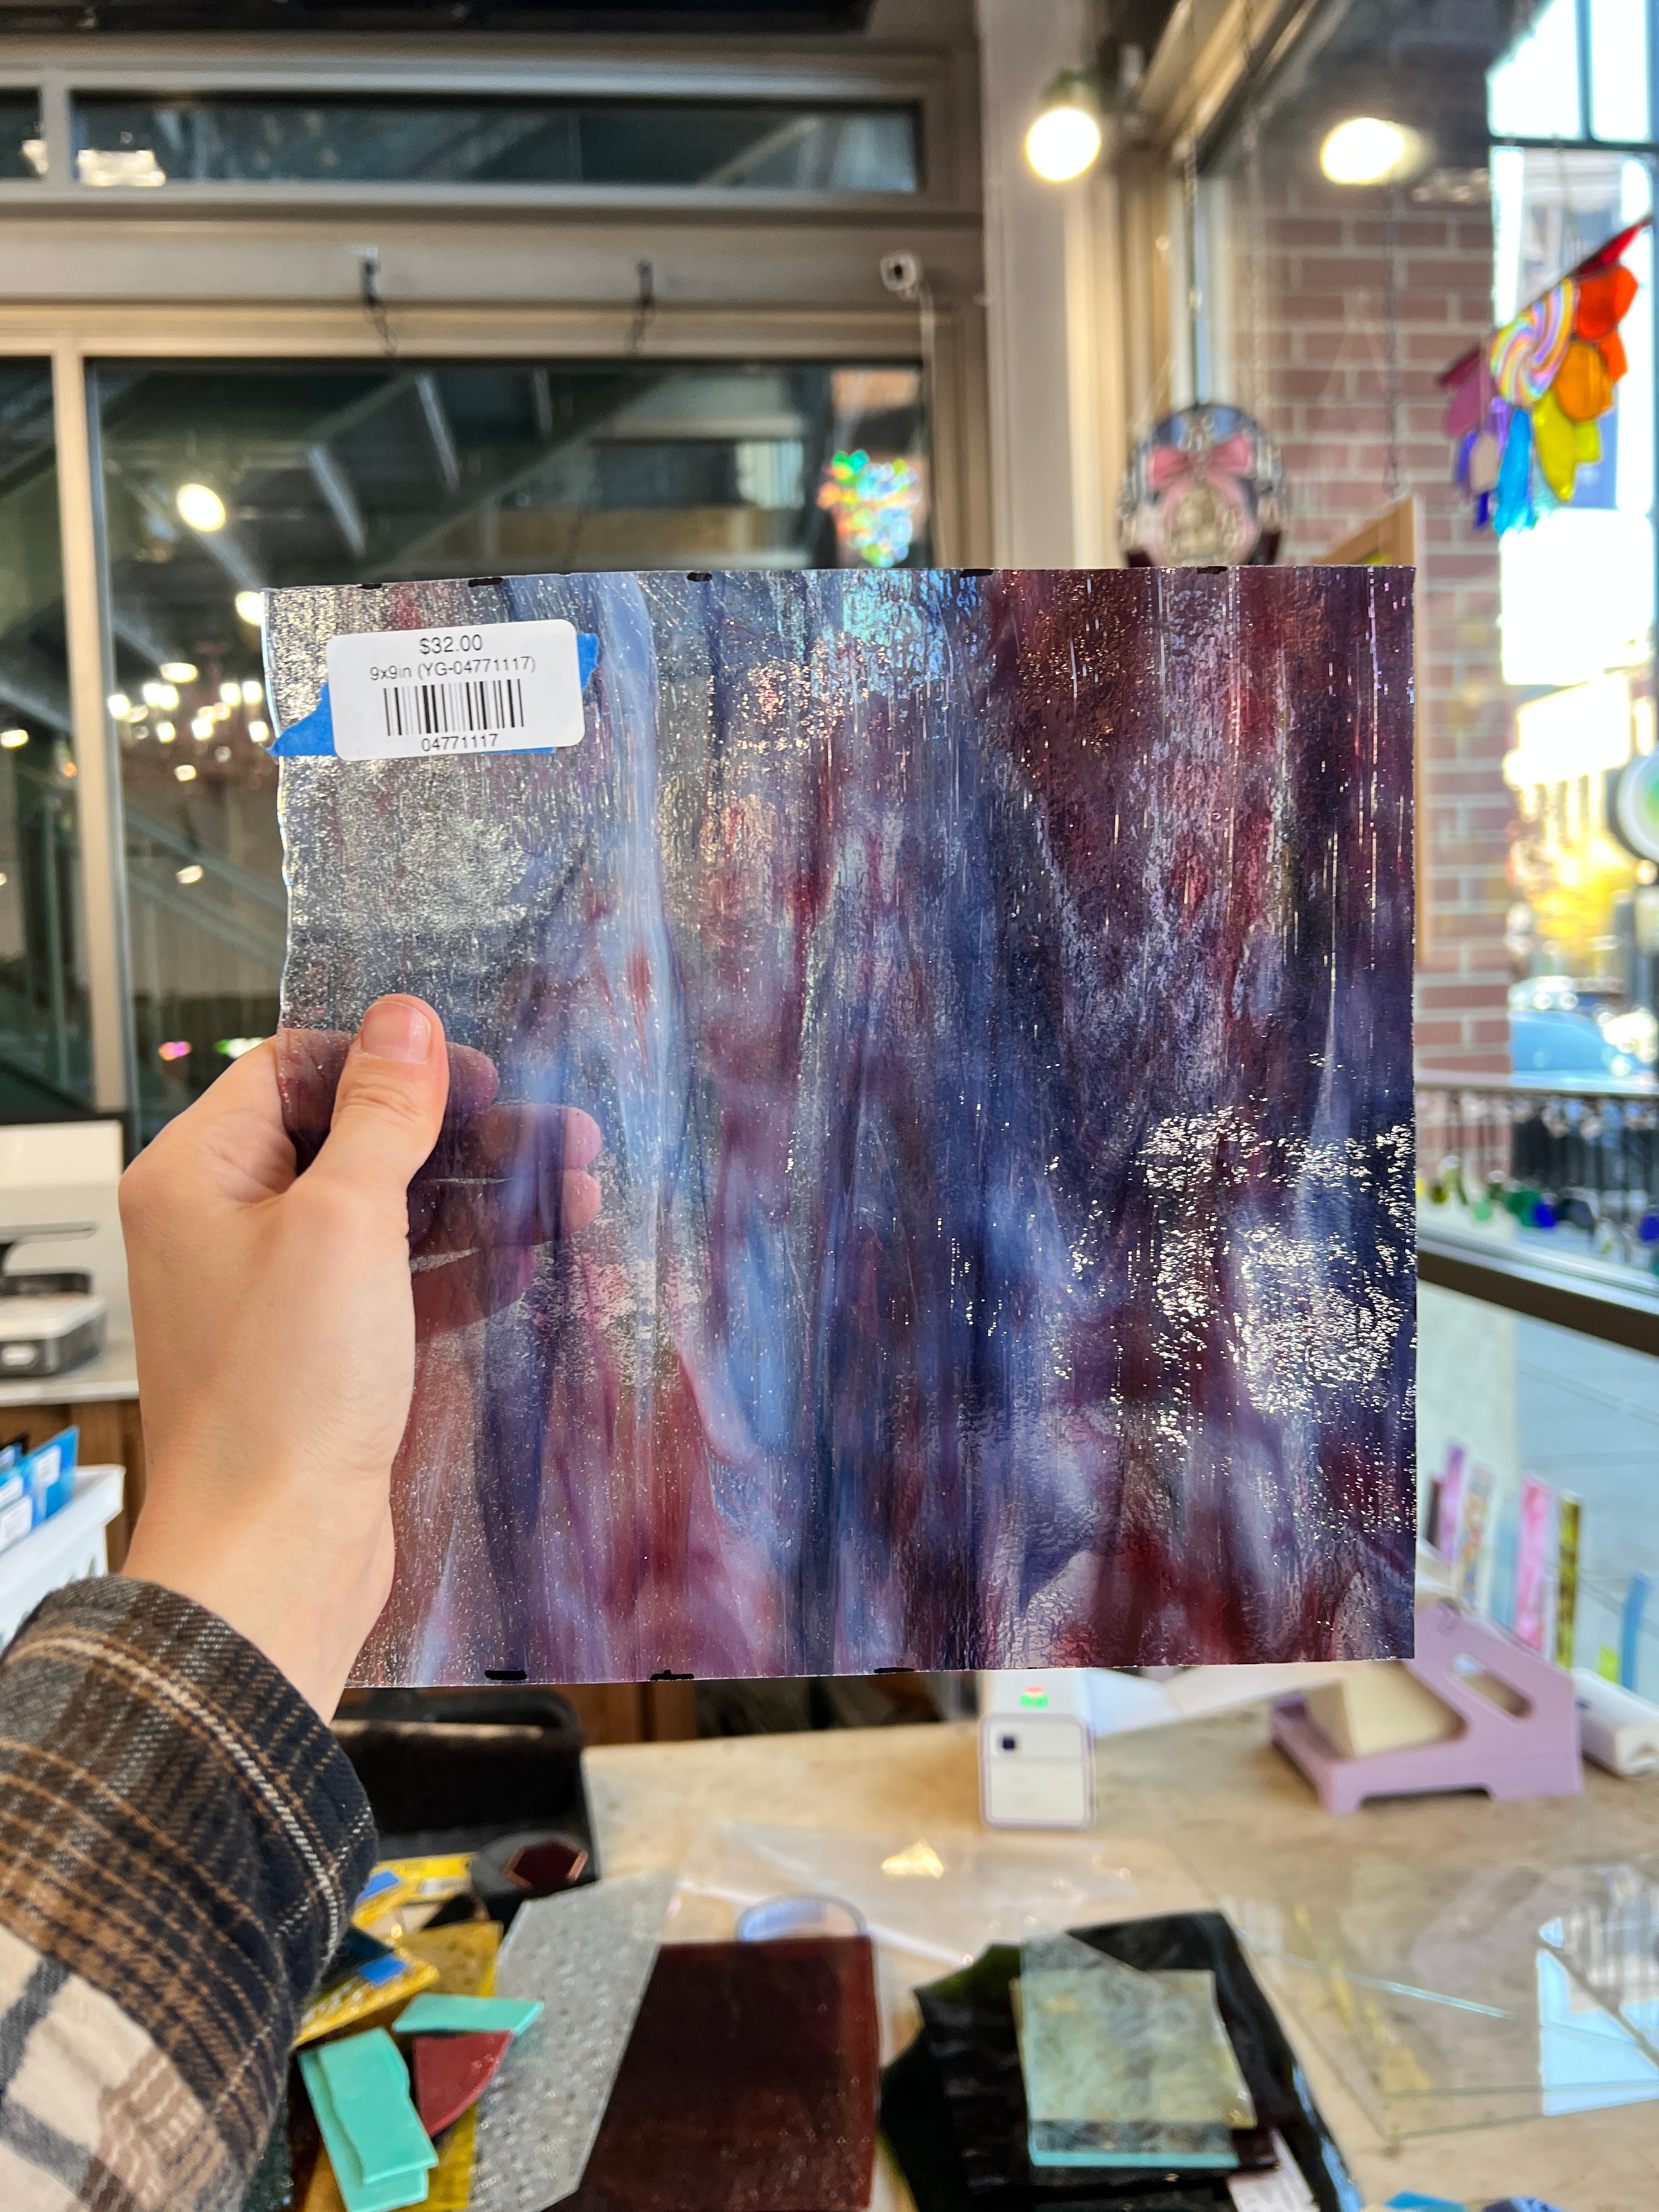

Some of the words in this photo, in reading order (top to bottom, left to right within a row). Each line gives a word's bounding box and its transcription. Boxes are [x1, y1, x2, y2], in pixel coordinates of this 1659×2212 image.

[420, 635, 482, 654] $32.00
[370, 665, 411, 680] 9x9in
[417, 657, 535, 679] (YG-04771117)
[422, 735, 498, 752] 04771117
